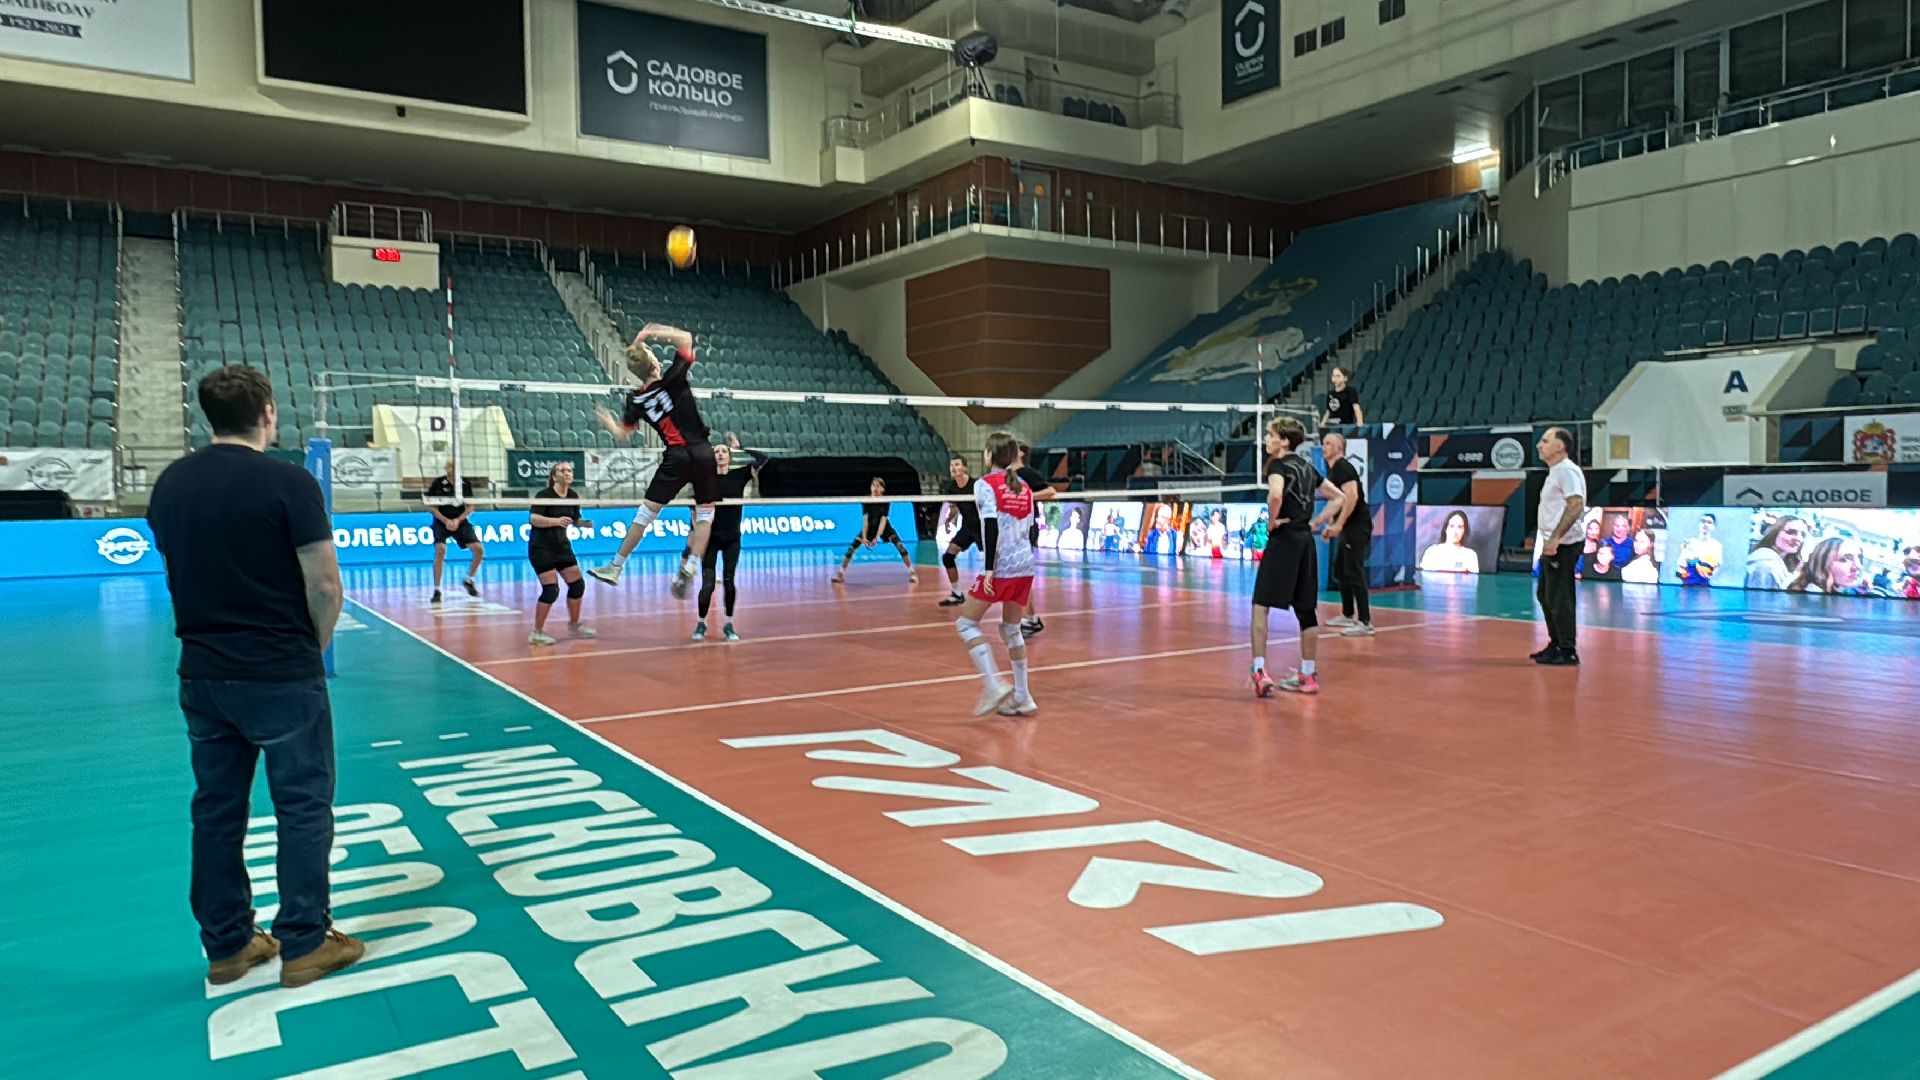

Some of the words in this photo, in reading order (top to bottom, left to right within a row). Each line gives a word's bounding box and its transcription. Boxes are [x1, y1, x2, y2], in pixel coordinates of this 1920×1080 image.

[646, 60, 744, 90] САДОВОЕ
[648, 79, 733, 107] КОЛЬЦО
[1723, 369, 1749, 394] A
[430, 416, 446, 433] D
[1772, 489, 1873, 505] САДОВОЕ
